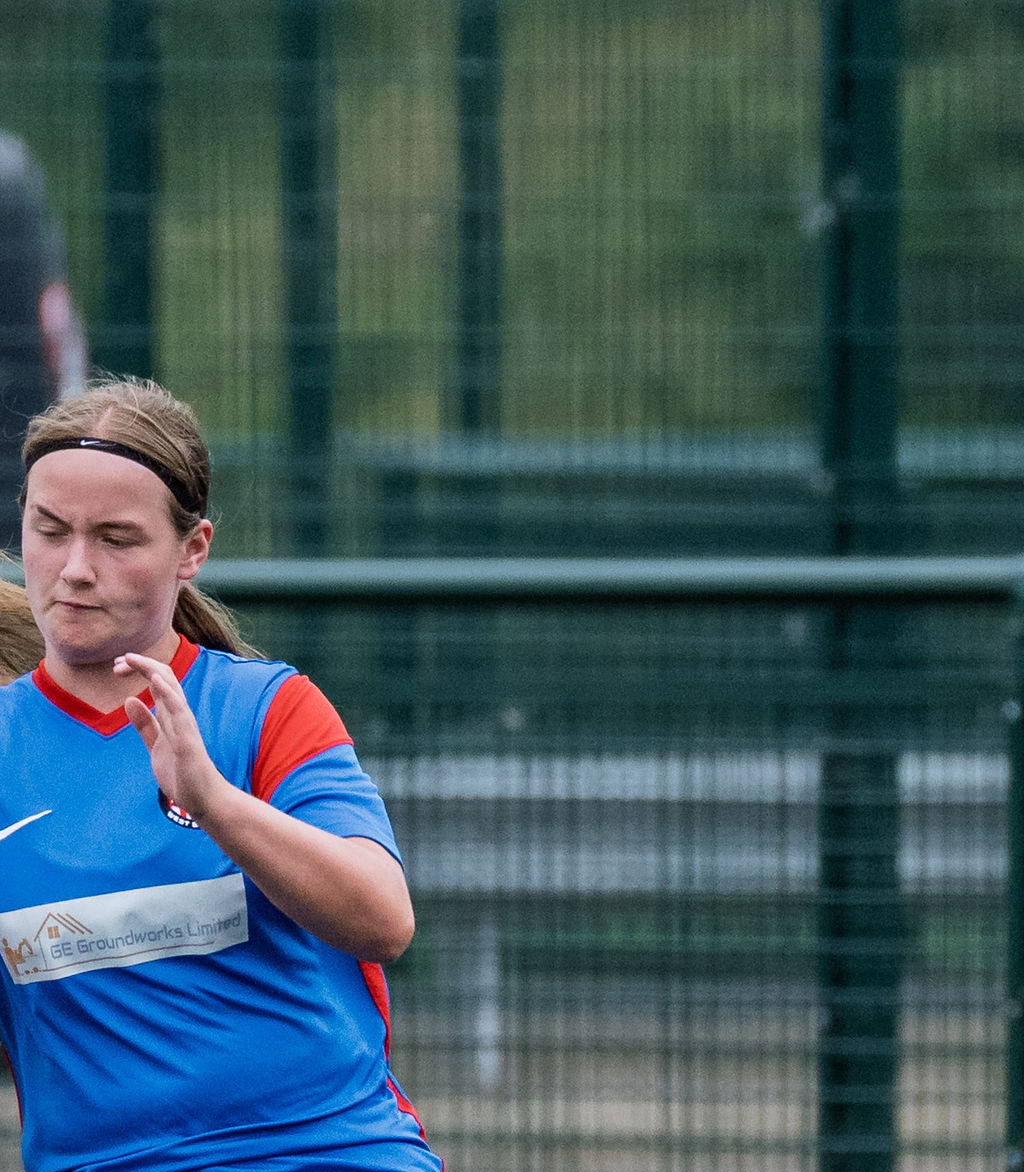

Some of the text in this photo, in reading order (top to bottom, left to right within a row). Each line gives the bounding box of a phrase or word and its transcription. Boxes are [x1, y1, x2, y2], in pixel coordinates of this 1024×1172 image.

[50, 912, 241, 960] GE Groundworks Limited
